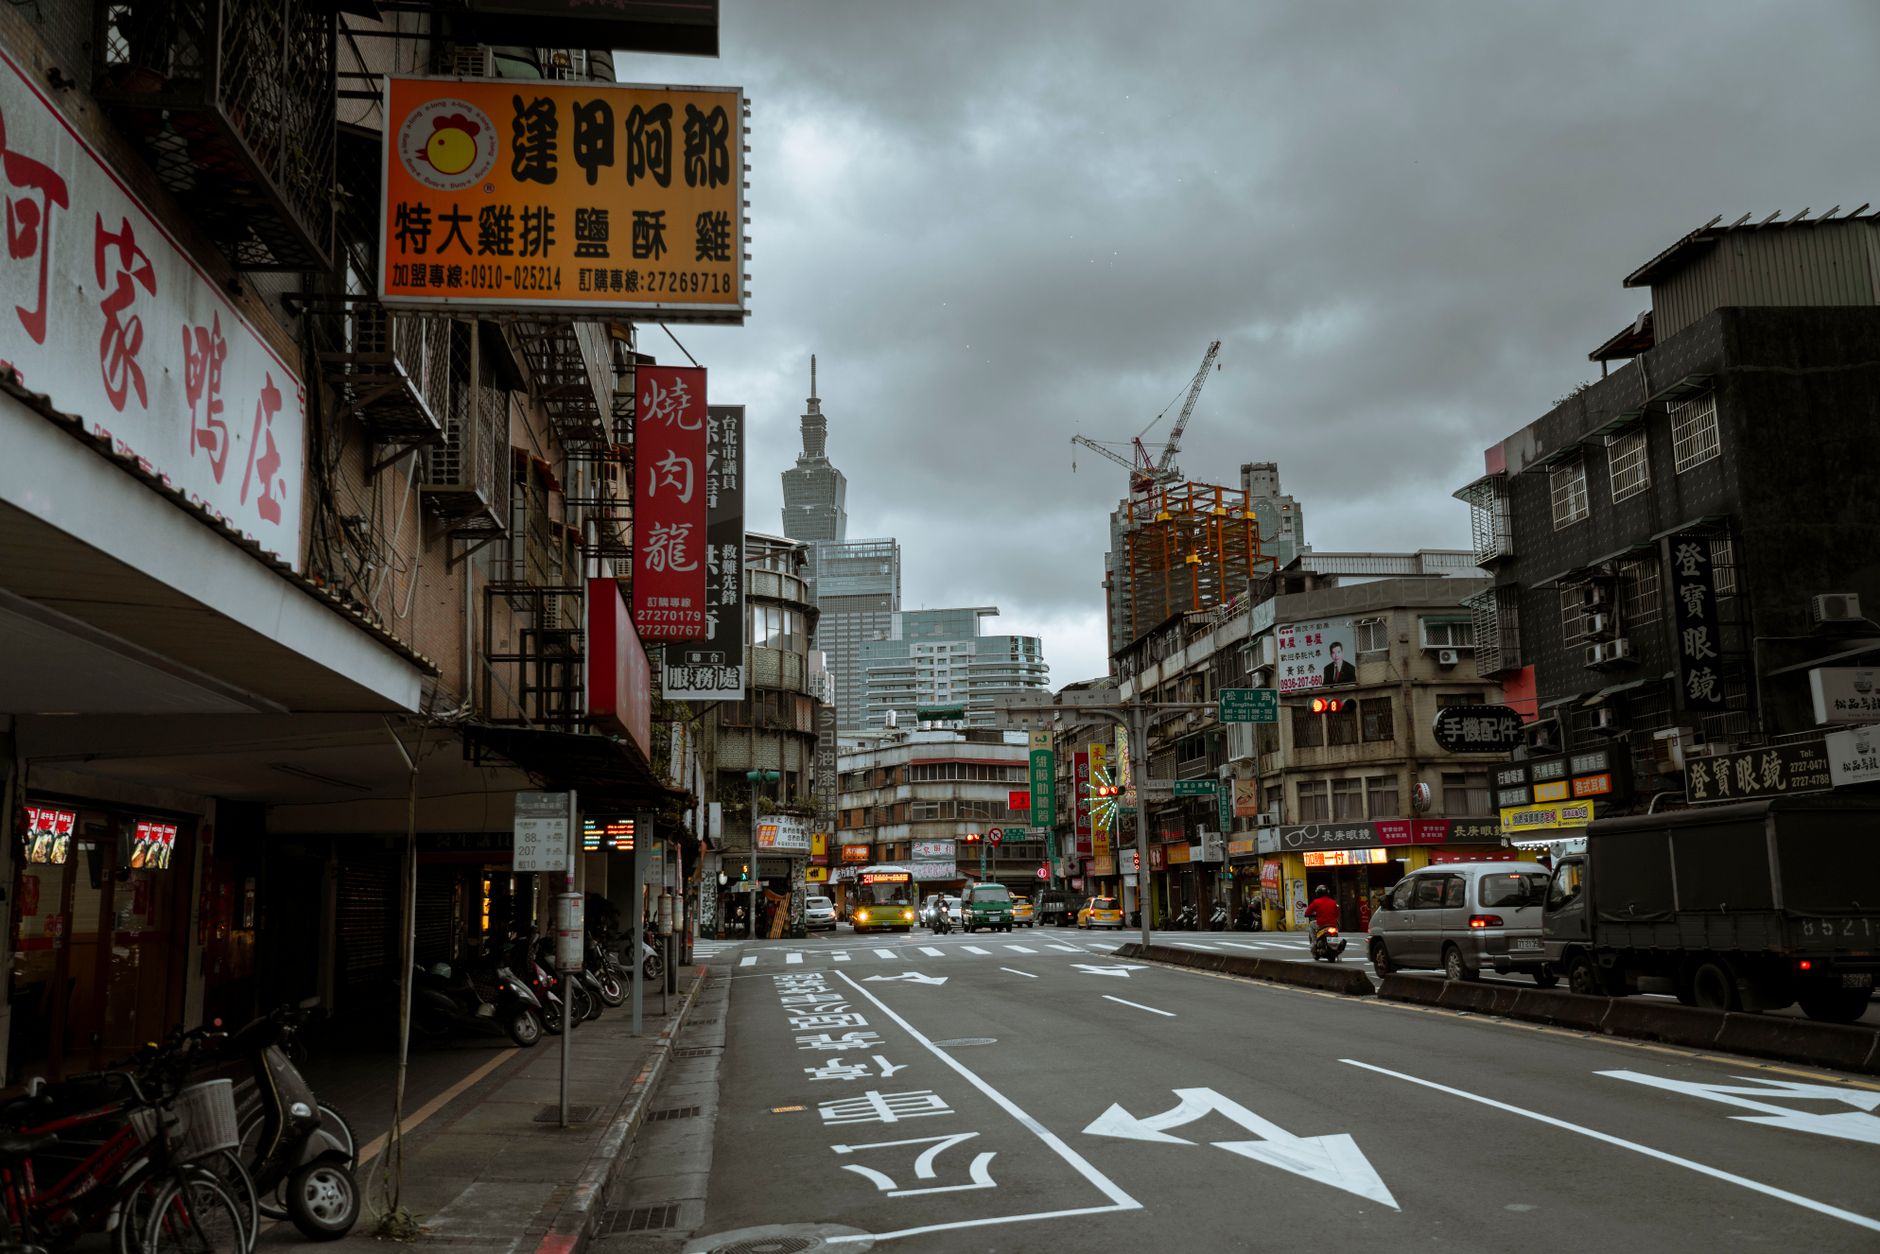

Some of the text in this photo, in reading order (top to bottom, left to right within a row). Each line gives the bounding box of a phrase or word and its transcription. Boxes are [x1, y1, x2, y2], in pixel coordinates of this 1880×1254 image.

[511, 94, 729, 188] 逢甲阿郎
[394, 202, 731, 262] 特大雞排 鹽酥雞
[642, 377, 703, 572] 燒肉龍
[721, 414, 738, 491] 台北市議員
[722, 544, 738, 606] 救難先鋒
[637, 610, 701, 622] 27270179
[637, 625, 701, 636] 27270767
[1675, 542, 1721, 705] 登寶眼鏡
[668, 667, 740, 690] 服務處
[1225, 691, 1271, 701] 松山路
[817, 710, 836, 787] 今日油漆
[1443, 716, 1519, 742] 手機配件
[1690, 750, 1787, 799] 登寶眼鏡
[1790, 759, 1827, 773] 2727-0471
[518, 846, 536, 856] 207
